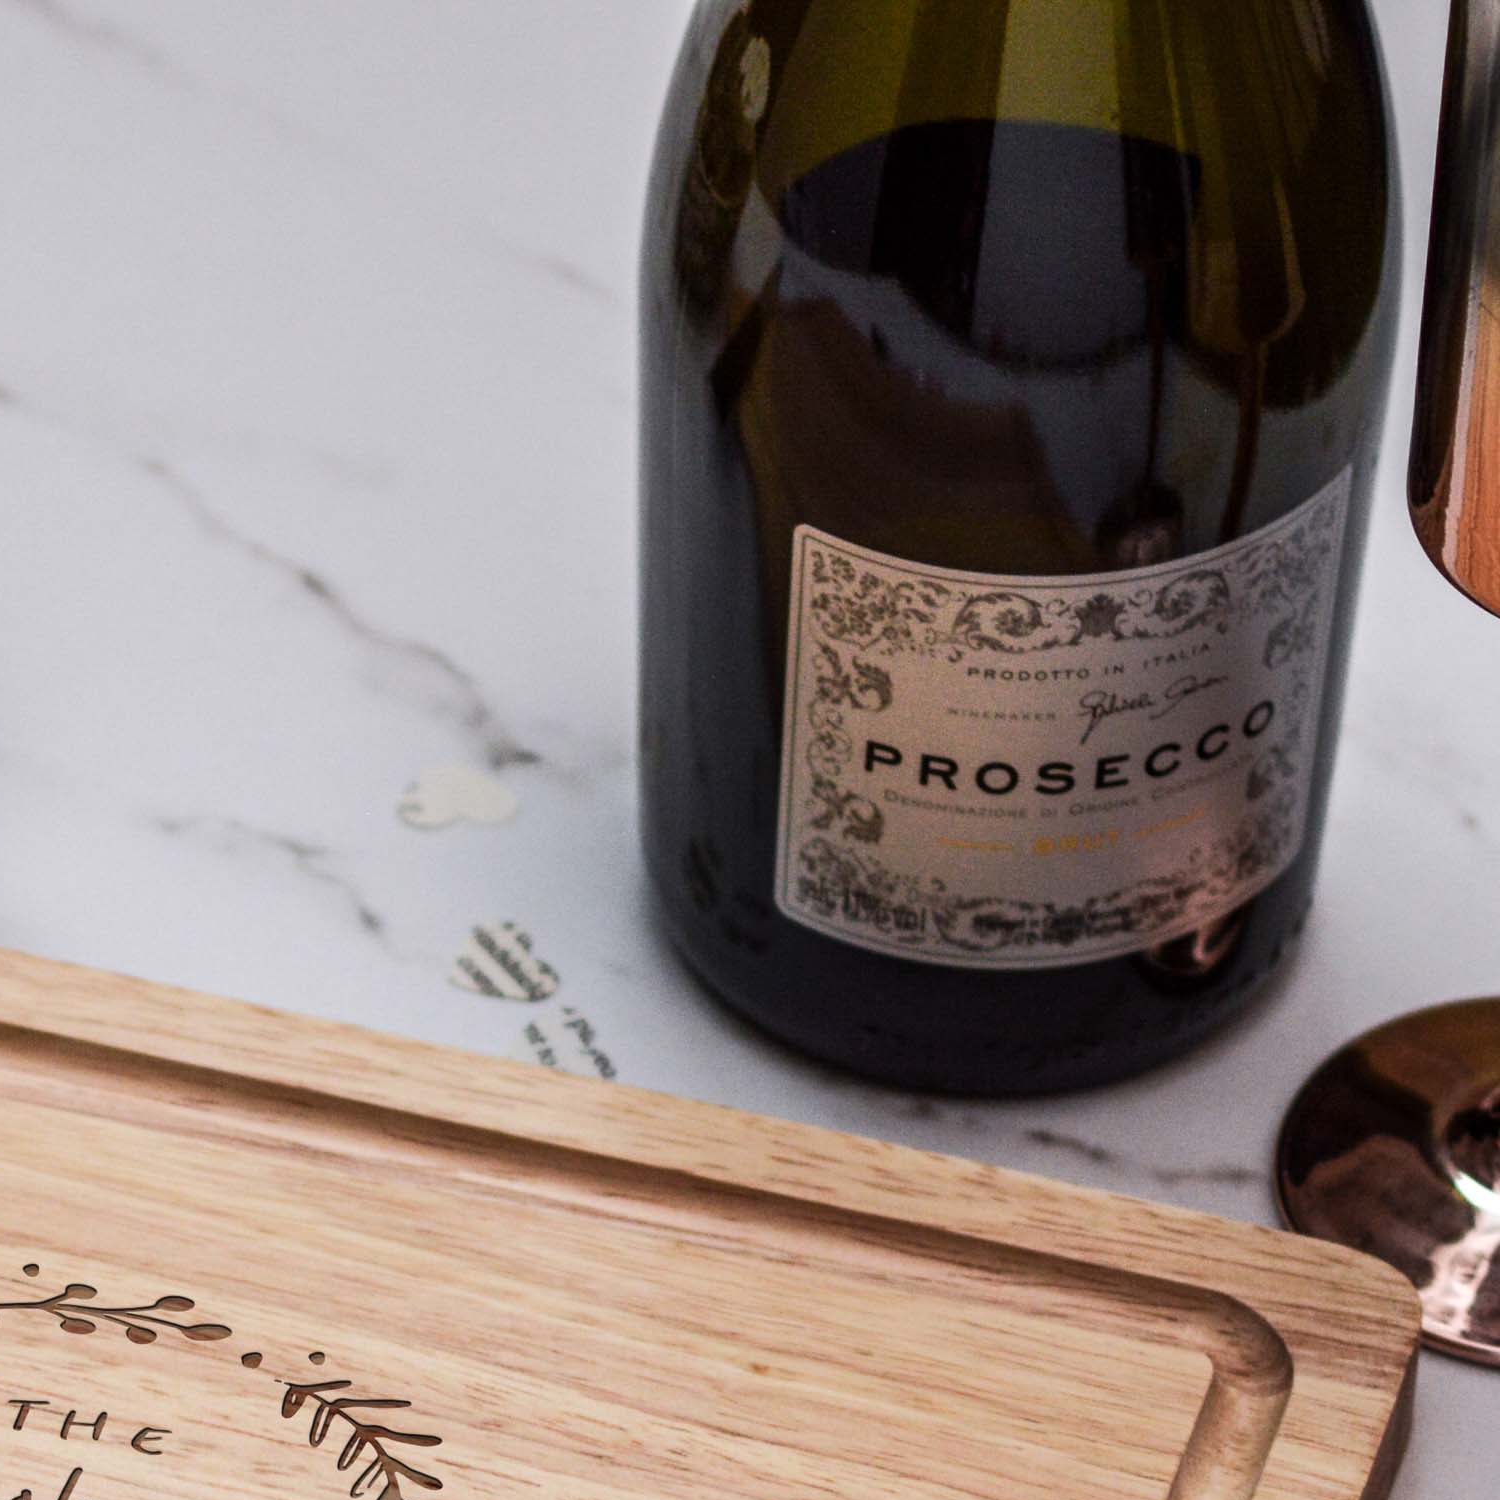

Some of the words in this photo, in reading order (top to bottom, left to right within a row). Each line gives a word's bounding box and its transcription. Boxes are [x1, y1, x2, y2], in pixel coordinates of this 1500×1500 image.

[966, 666, 1091, 682] PRODOTTO
[1103, 664, 1126, 676] IN
[1143, 643, 1211, 671] ITALIA
[864, 700, 1275, 796] PROSECCO
[8, 1399, 173, 1455] THE
